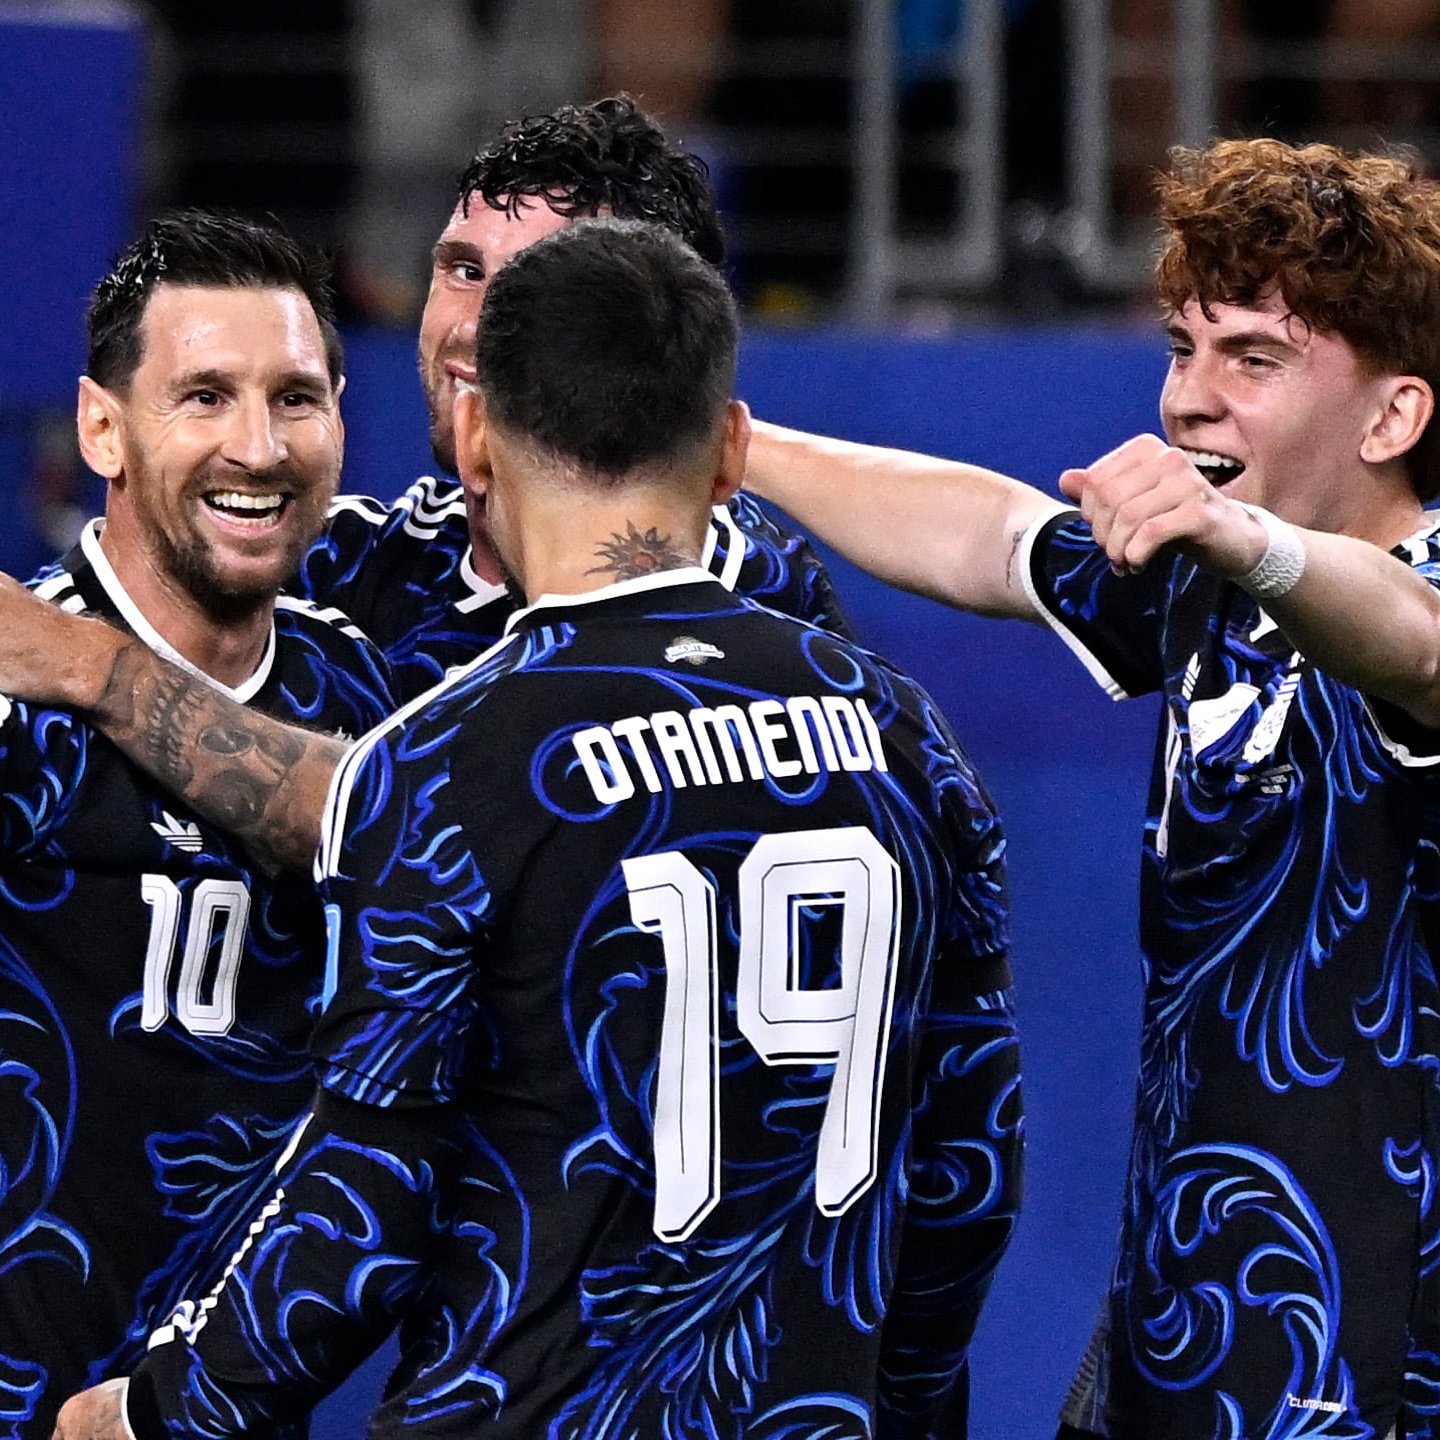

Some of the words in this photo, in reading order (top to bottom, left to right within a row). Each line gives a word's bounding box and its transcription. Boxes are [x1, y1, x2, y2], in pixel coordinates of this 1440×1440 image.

[572, 696, 889, 805] OTAMENDI
[140, 873, 252, 1037] 10
[621, 825, 903, 1245] 19
